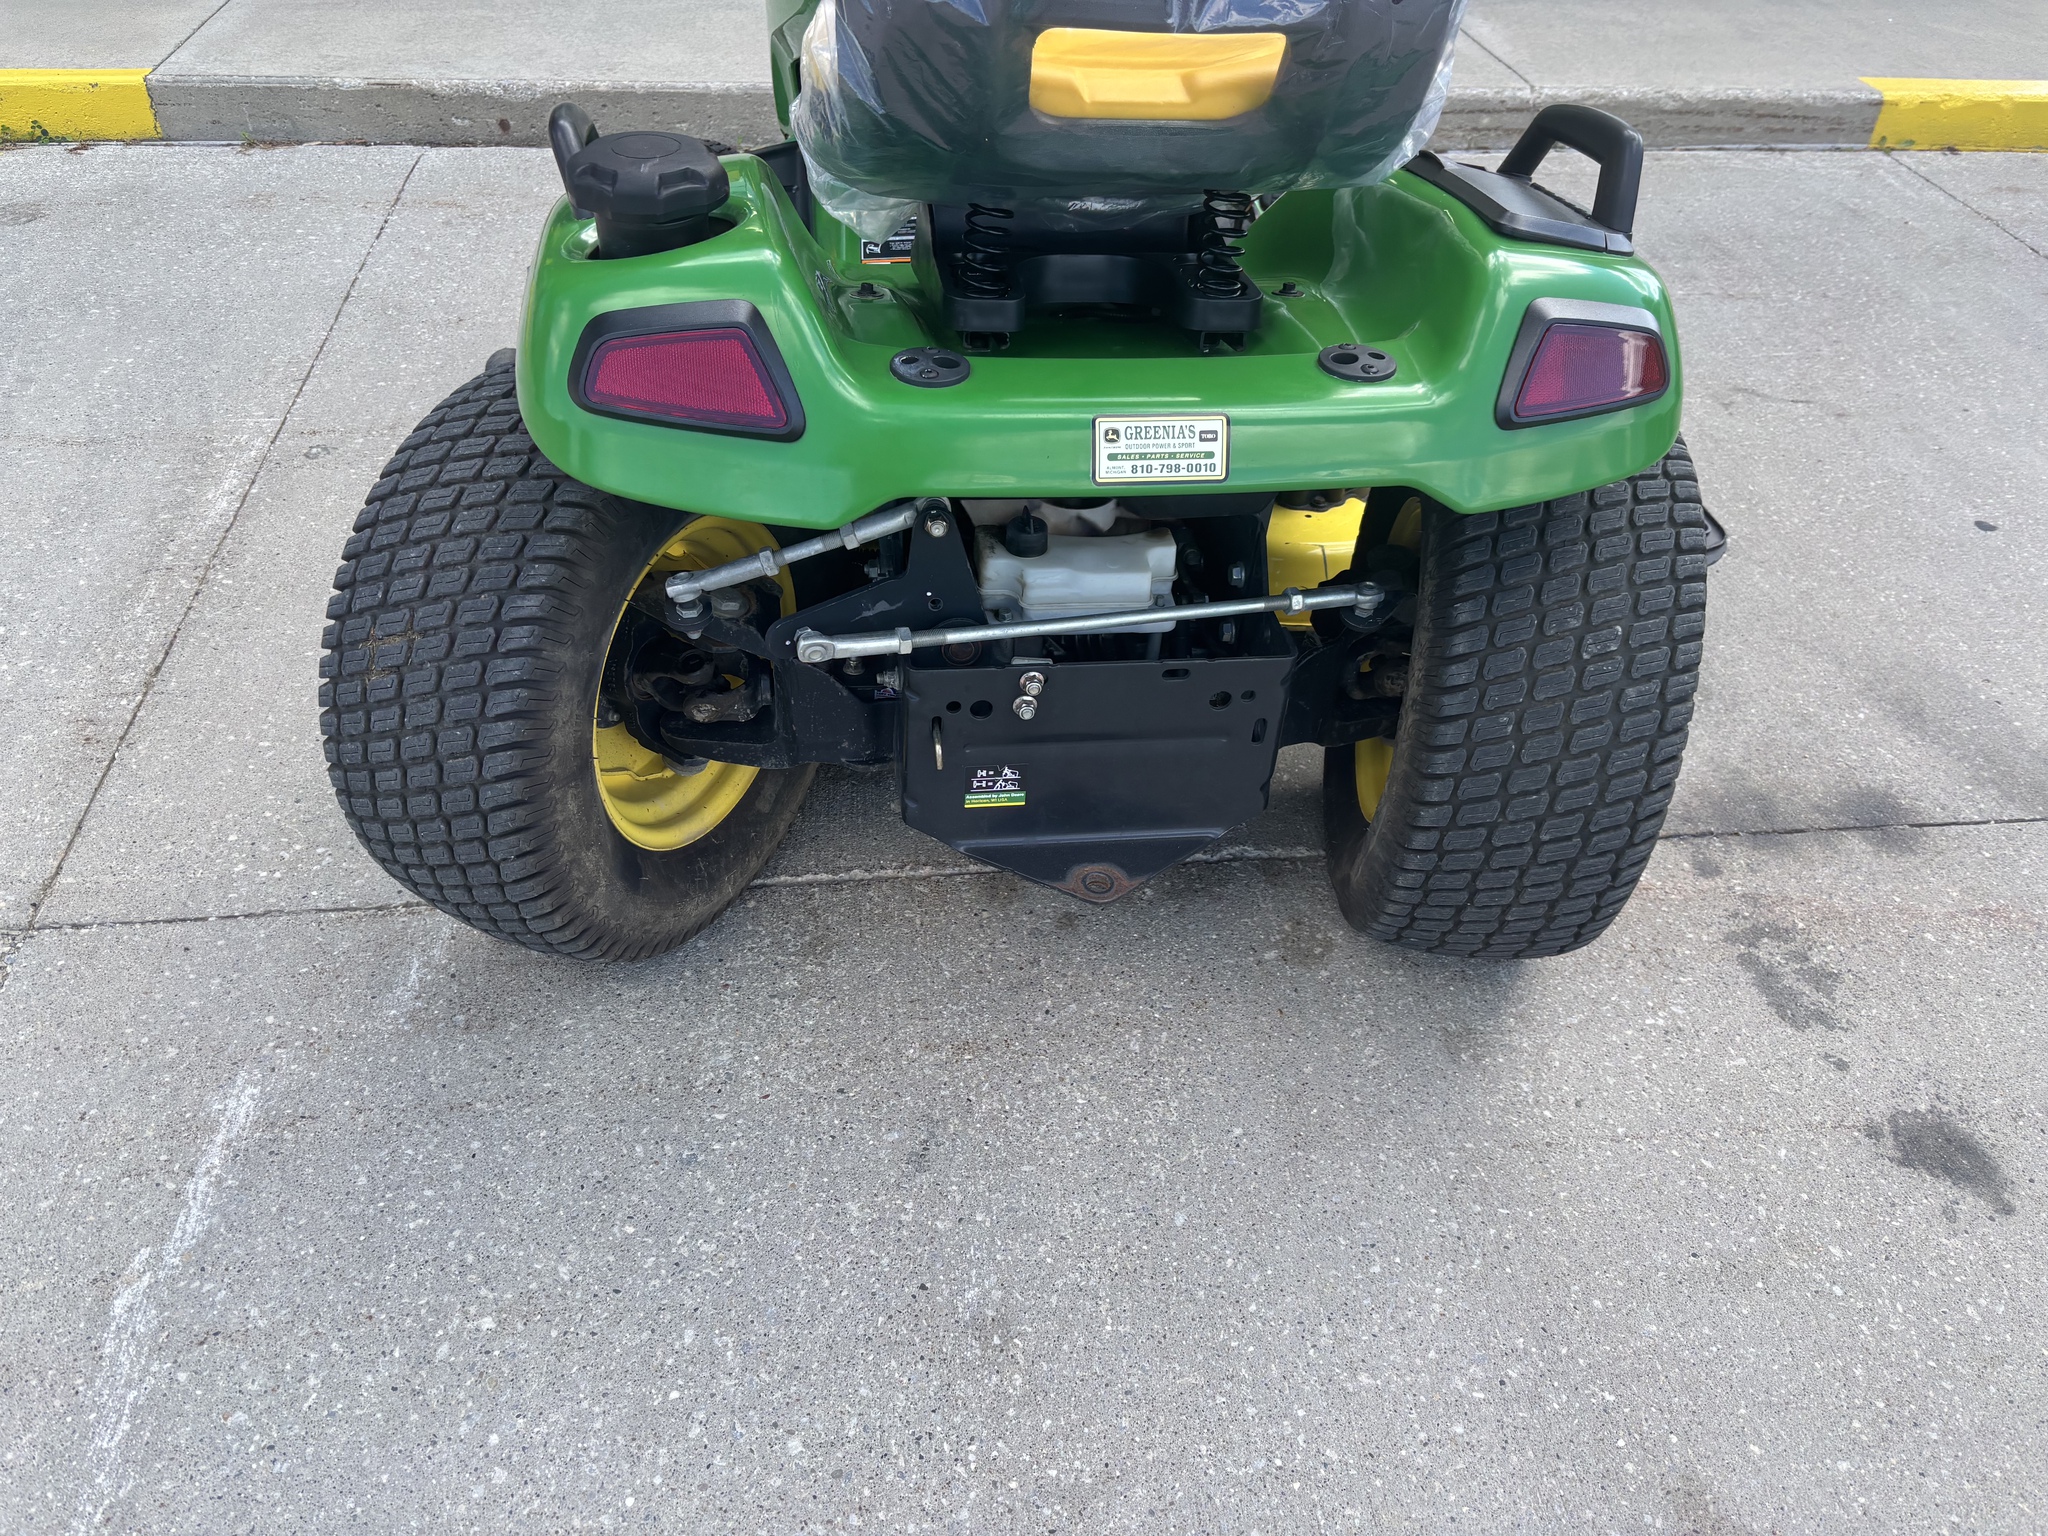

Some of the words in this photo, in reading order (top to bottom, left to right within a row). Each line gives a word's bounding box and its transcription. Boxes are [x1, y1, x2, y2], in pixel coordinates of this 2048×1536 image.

[1124, 424, 1196, 441] GREENIA'S
[1124, 442, 1151, 450] OUTDOOR
[1131, 462, 1217, 474] 810-798-0010
